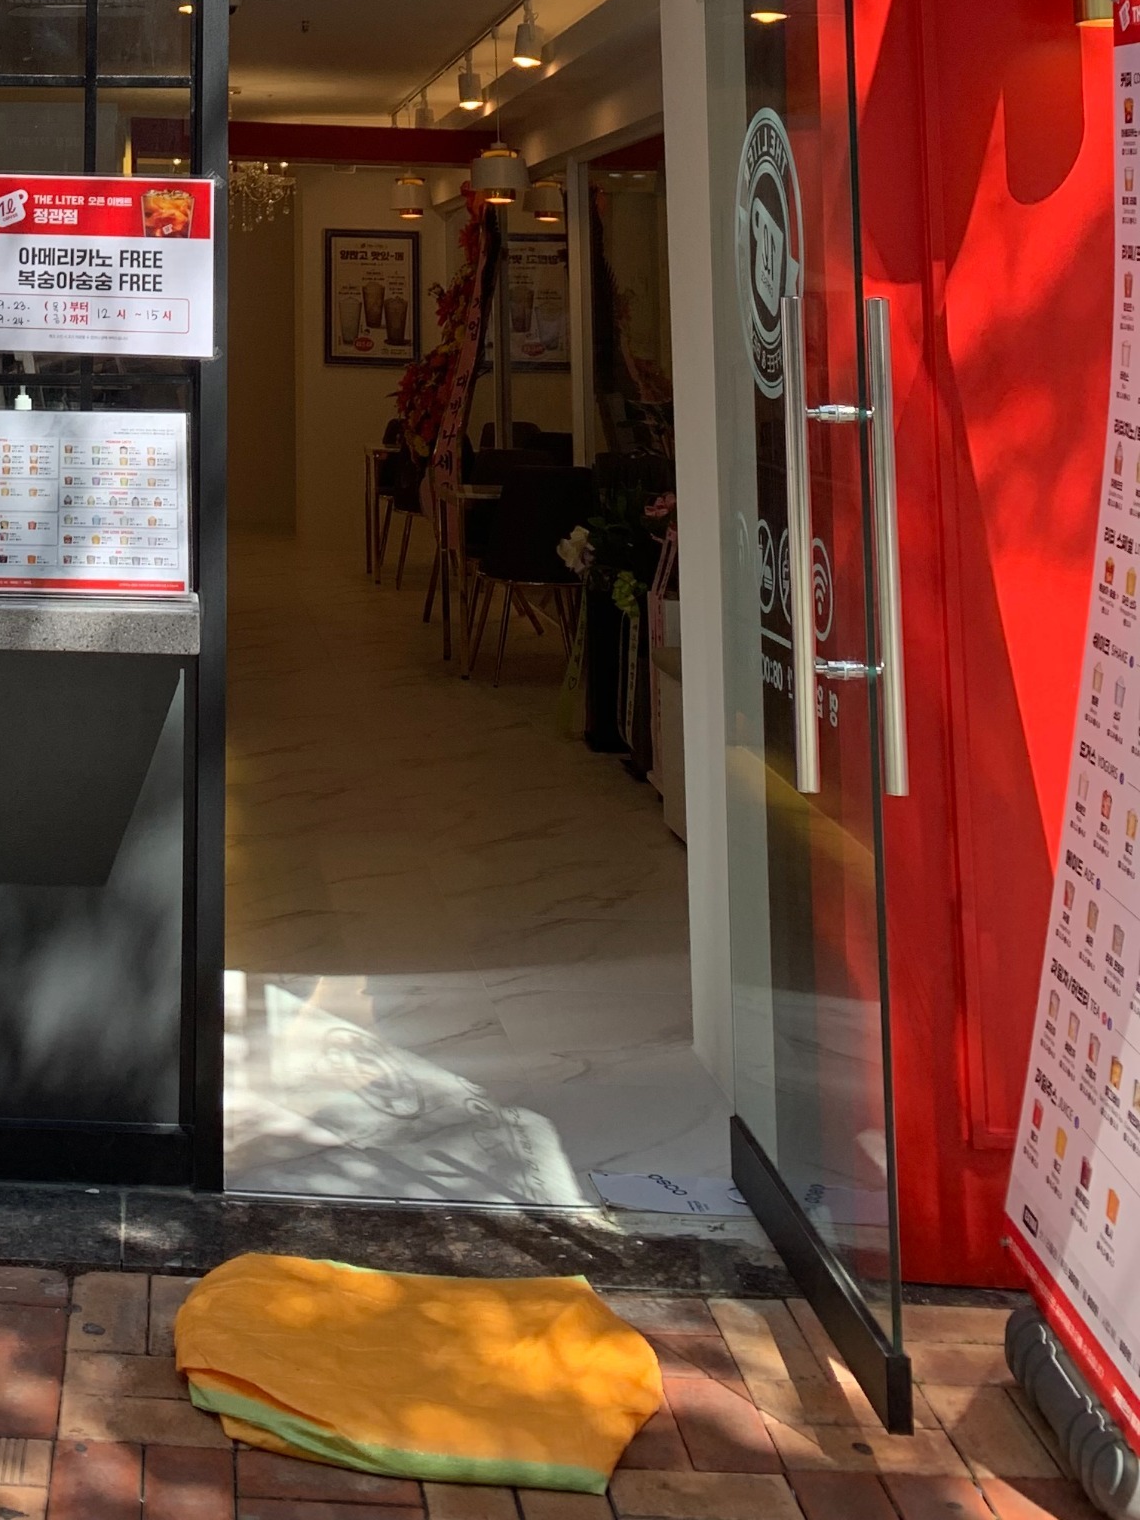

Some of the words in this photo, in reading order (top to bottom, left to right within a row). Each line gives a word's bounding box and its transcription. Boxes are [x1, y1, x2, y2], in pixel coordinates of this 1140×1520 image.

[33, 194, 53, 206] THE
[55, 194, 85, 206] LITER
[33, 207, 79, 225] 정관점
[18, 246, 113, 268] 아메리카노
[119, 249, 164, 269] FREE
[17, 270, 113, 292] 복숭아숭숭
[119, 272, 164, 292] FREE
[1084, 866, 1096, 886] ADE
[1090, 998, 1101, 1020] TEA
